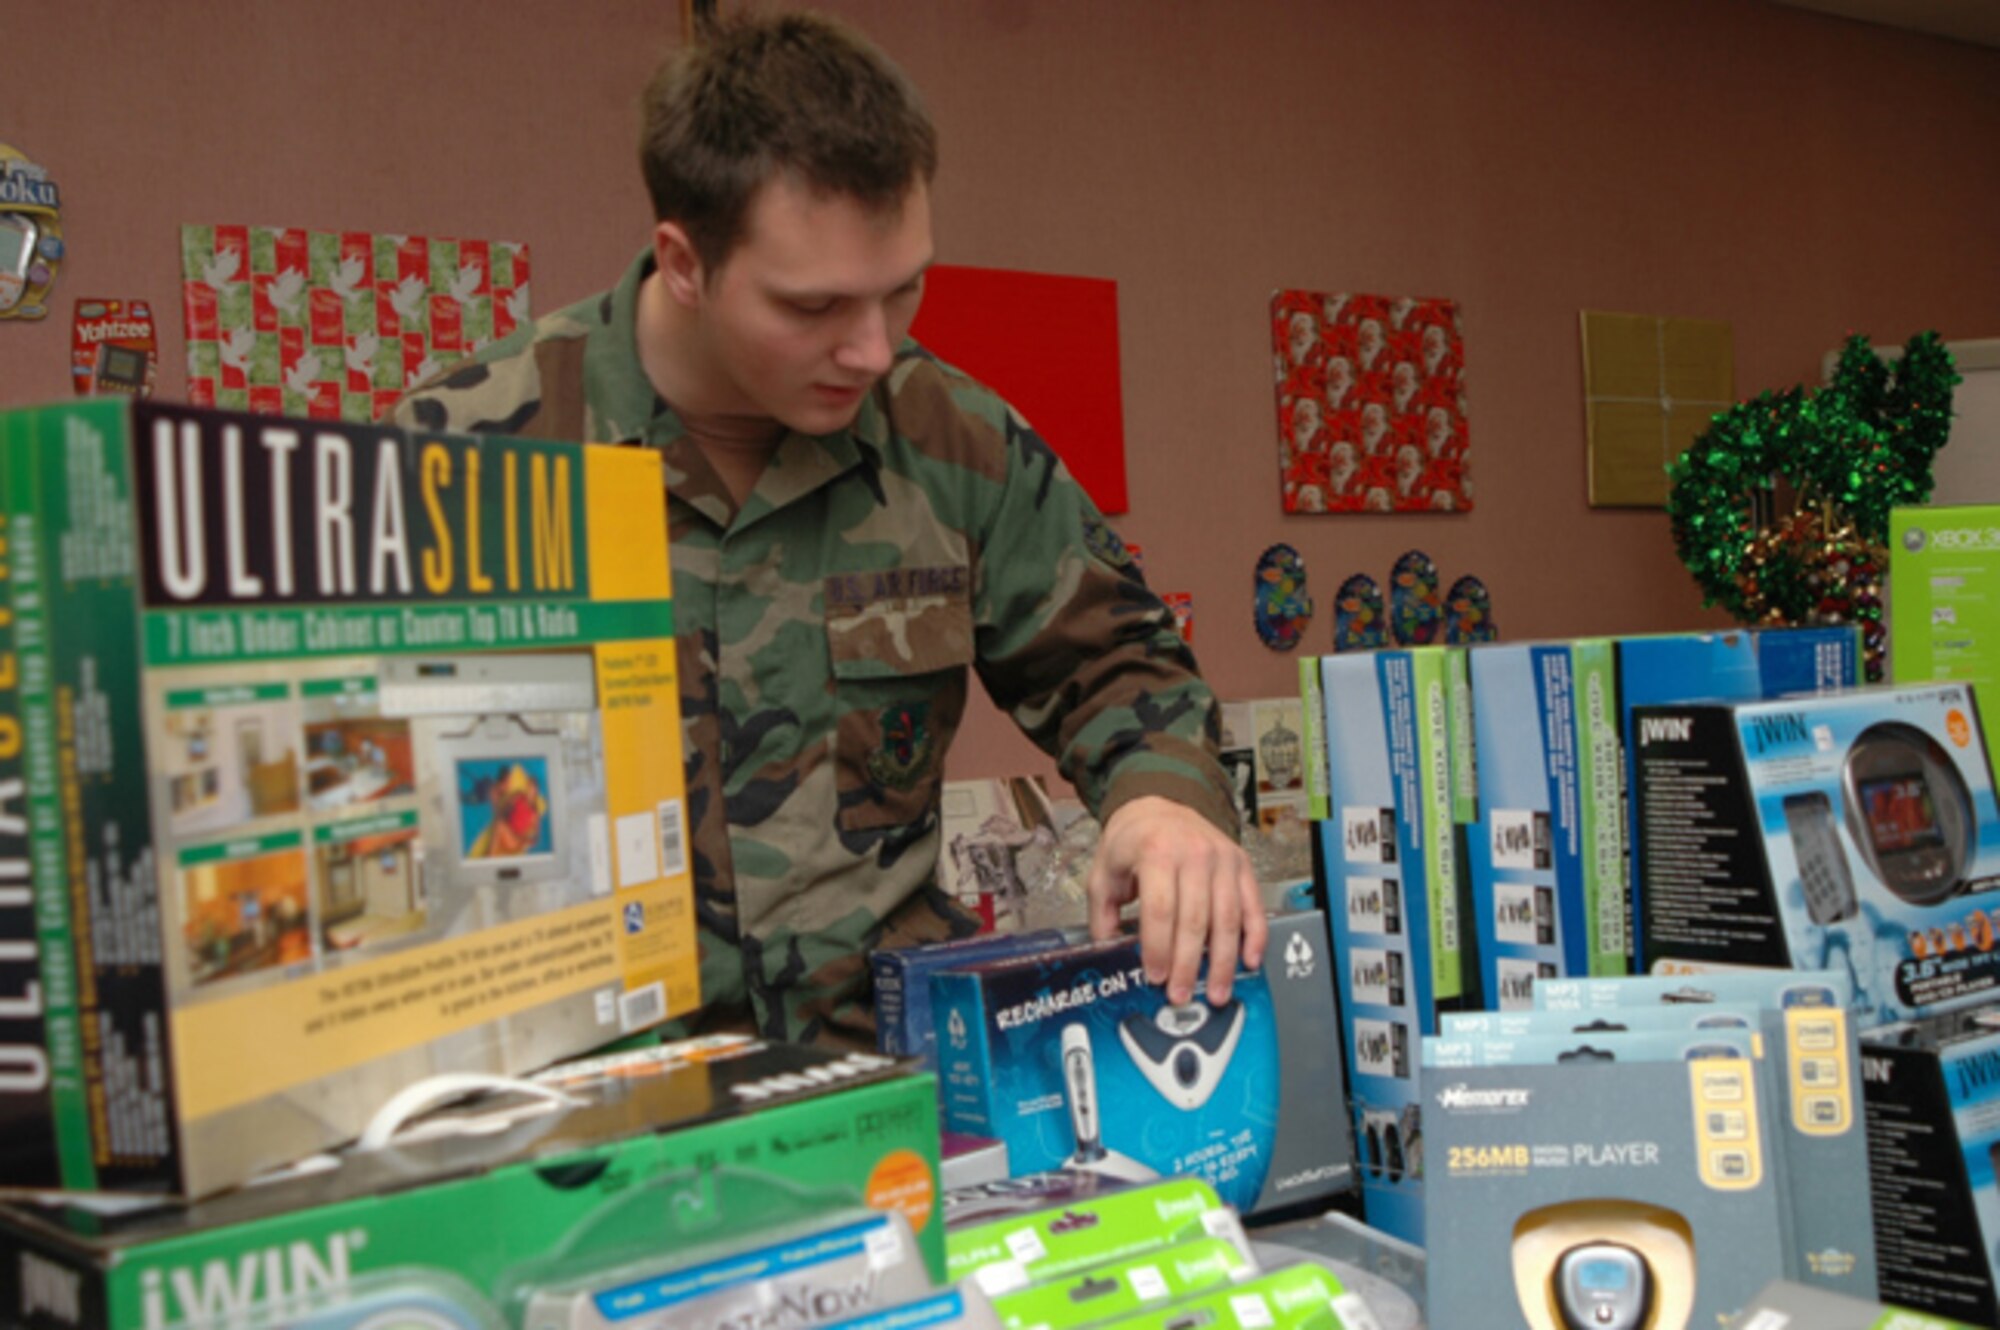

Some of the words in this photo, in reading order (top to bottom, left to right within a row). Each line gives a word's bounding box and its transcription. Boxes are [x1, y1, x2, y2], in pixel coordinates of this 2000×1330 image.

[77, 319, 150, 343] Yahtzee
[11, 514, 36, 582] Radio
[1931, 529, 1981, 549] XBOX
[908, 565, 968, 596] FORCE
[15, 616, 42, 647] TV
[166, 613, 181, 657] 7
[188, 614, 235, 655] Inch
[241, 612, 298, 653] Under
[304, 609, 373, 650] Cabinet
[378, 616, 397, 646] or
[402, 608, 464, 644] Counter
[468, 606, 496, 643] Top
[499, 606, 518, 639] TV
[537, 605, 578, 637] Radio
[21, 652, 46, 695] Top
[27, 704, 57, 797] Counter
[36, 840, 66, 930] Cabinet
[45, 938, 73, 1007] Under
[1910, 972, 1962, 992] PORTABLE
[1957, 977, 1994, 993] PLAYER
[996, 983, 1097, 1031] RECHARGE
[1100, 970, 1128, 997] ON
[1545, 983, 1579, 997] MP3
[1454, 1018, 1489, 1032] MP3
[50, 1015, 77, 1069] Inch
[1435, 1041, 1473, 1056] MP3
[1441, 1084, 1530, 1108] Memorex
[1448, 1144, 1530, 1169] 256MB
[1573, 1142, 1659, 1166] PLAYER
